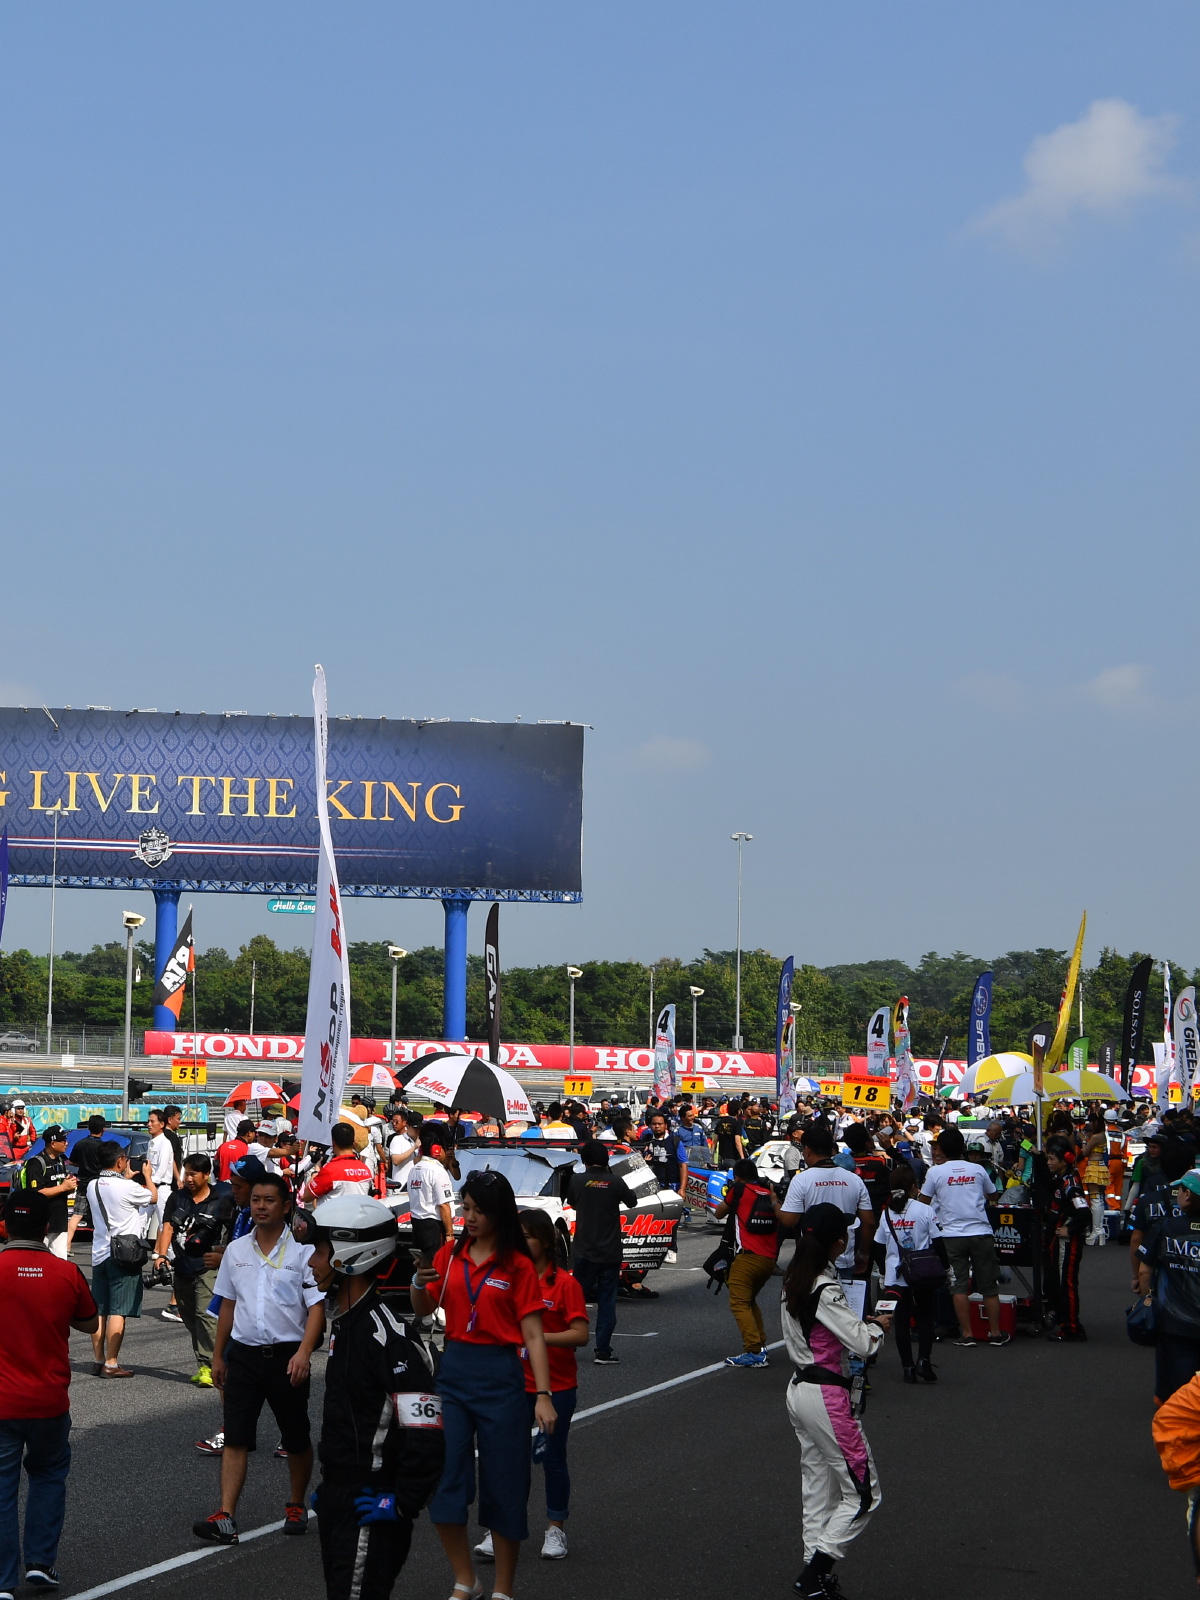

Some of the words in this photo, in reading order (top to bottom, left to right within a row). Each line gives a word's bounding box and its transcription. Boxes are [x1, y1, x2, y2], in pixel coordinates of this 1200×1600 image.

[28, 769, 159, 814] LIVE
[177, 774, 297, 818] THE
[314, 779, 465, 823] KING
[272, 900, 296, 911] Hello
[657, 1009, 670, 1033] 4
[1130, 990, 1142, 1049] CVSTOS
[871, 1013, 884, 1039] 4
[171, 1034, 305, 1059] HONDA
[595, 1048, 754, 1075] HONDA
[179, 1067, 199, 1080] 55
[414, 1076, 454, 1096] B-Max
[690, 1082, 696, 1090] 4
[852, 1076, 889, 1084] AUTOBACS
[413, 1084, 432, 1094] Racing
[571, 1082, 585, 1092] 11
[824, 1084, 836, 1092] 61
[853, 1085, 879, 1102] 18
[507, 1099, 528, 1111] B-Max
[40, 1105, 69, 1127] Open
[344, 1168, 369, 1177] TOYOTA
[947, 1176, 976, 1184] B-Max
[1003, 1215, 1010, 1223] 3
[994, 1226, 1021, 1238] MAC
